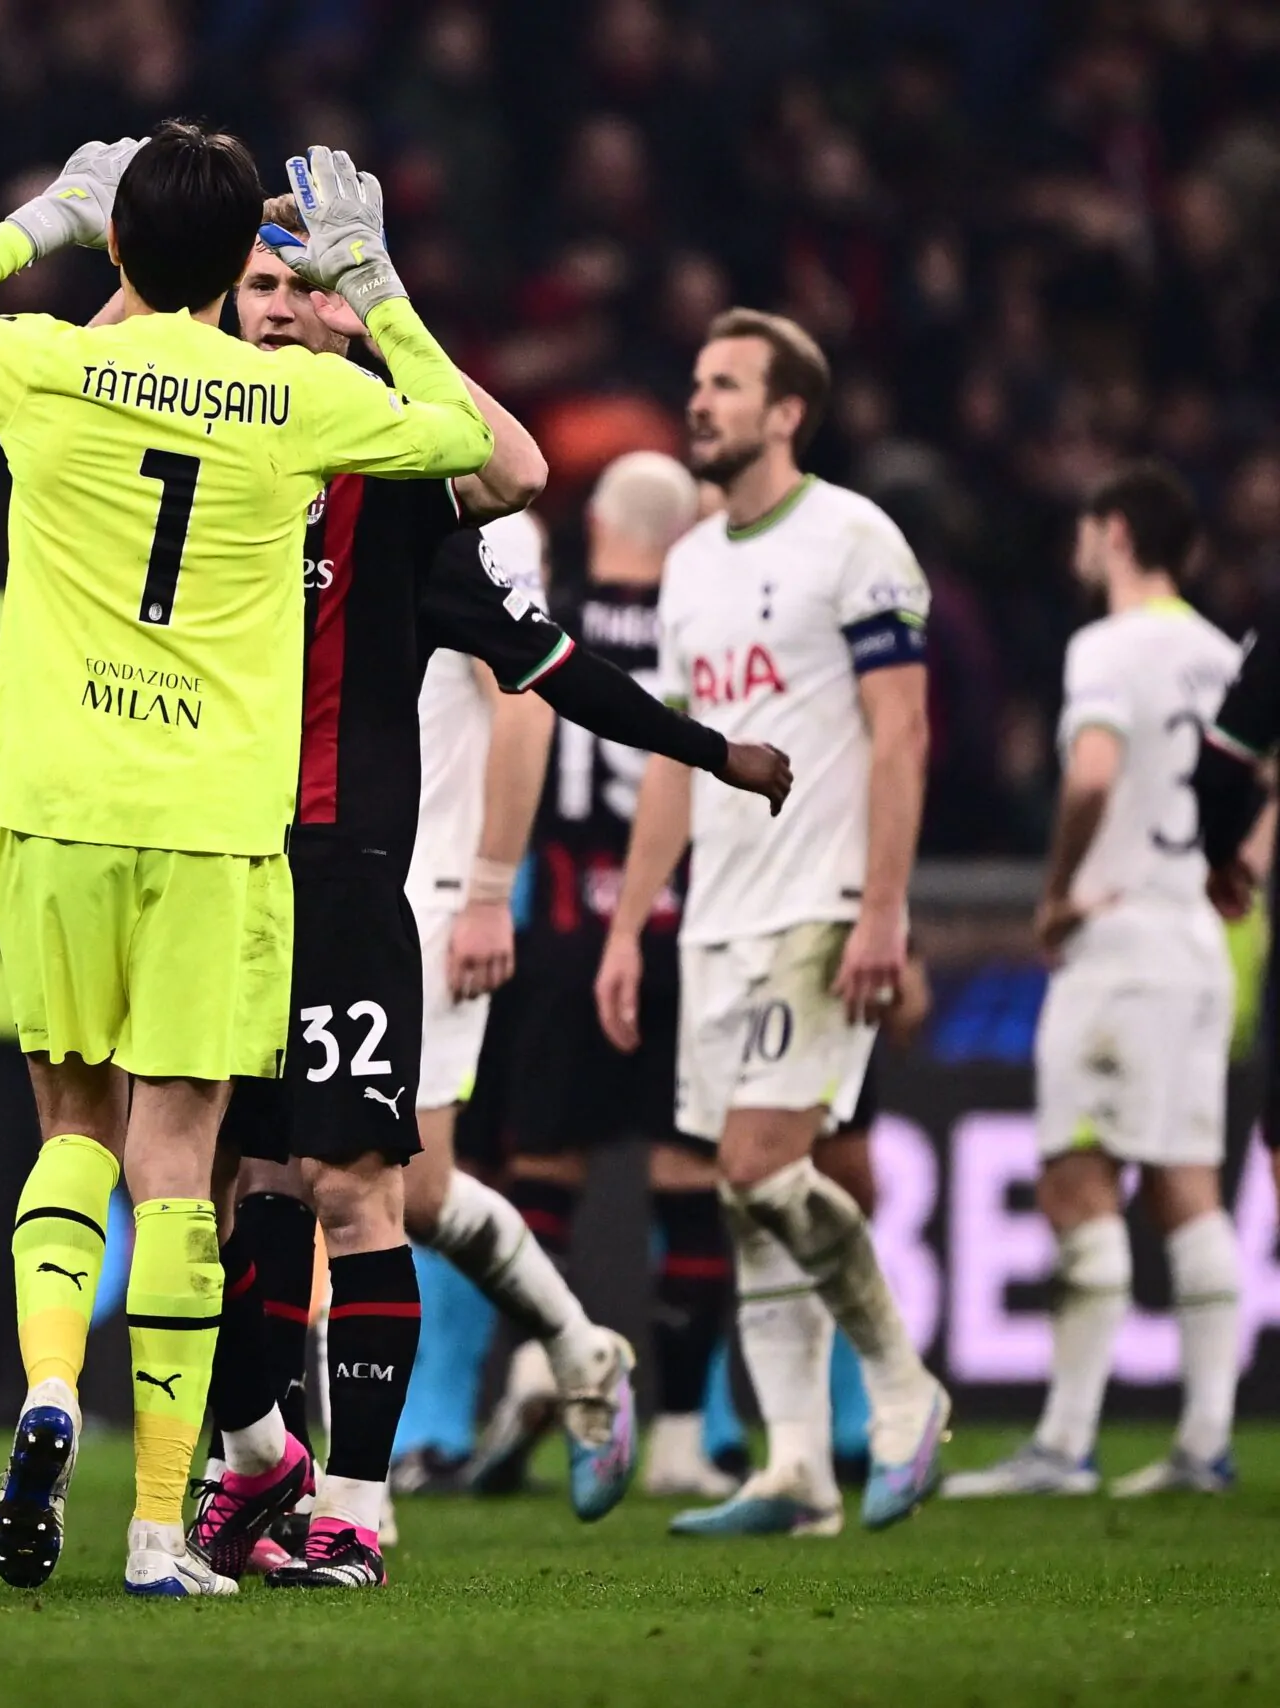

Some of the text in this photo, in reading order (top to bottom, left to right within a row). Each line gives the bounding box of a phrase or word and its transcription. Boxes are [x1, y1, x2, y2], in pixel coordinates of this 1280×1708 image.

[290, 159, 316, 210] reusch
[139, 448, 201, 626] 1
[86, 657, 205, 694] FONDAZIONE
[81, 680, 203, 730] MILAN
[300, 1000, 392, 1082] 32
[336, 1362, 395, 1382] ACM
